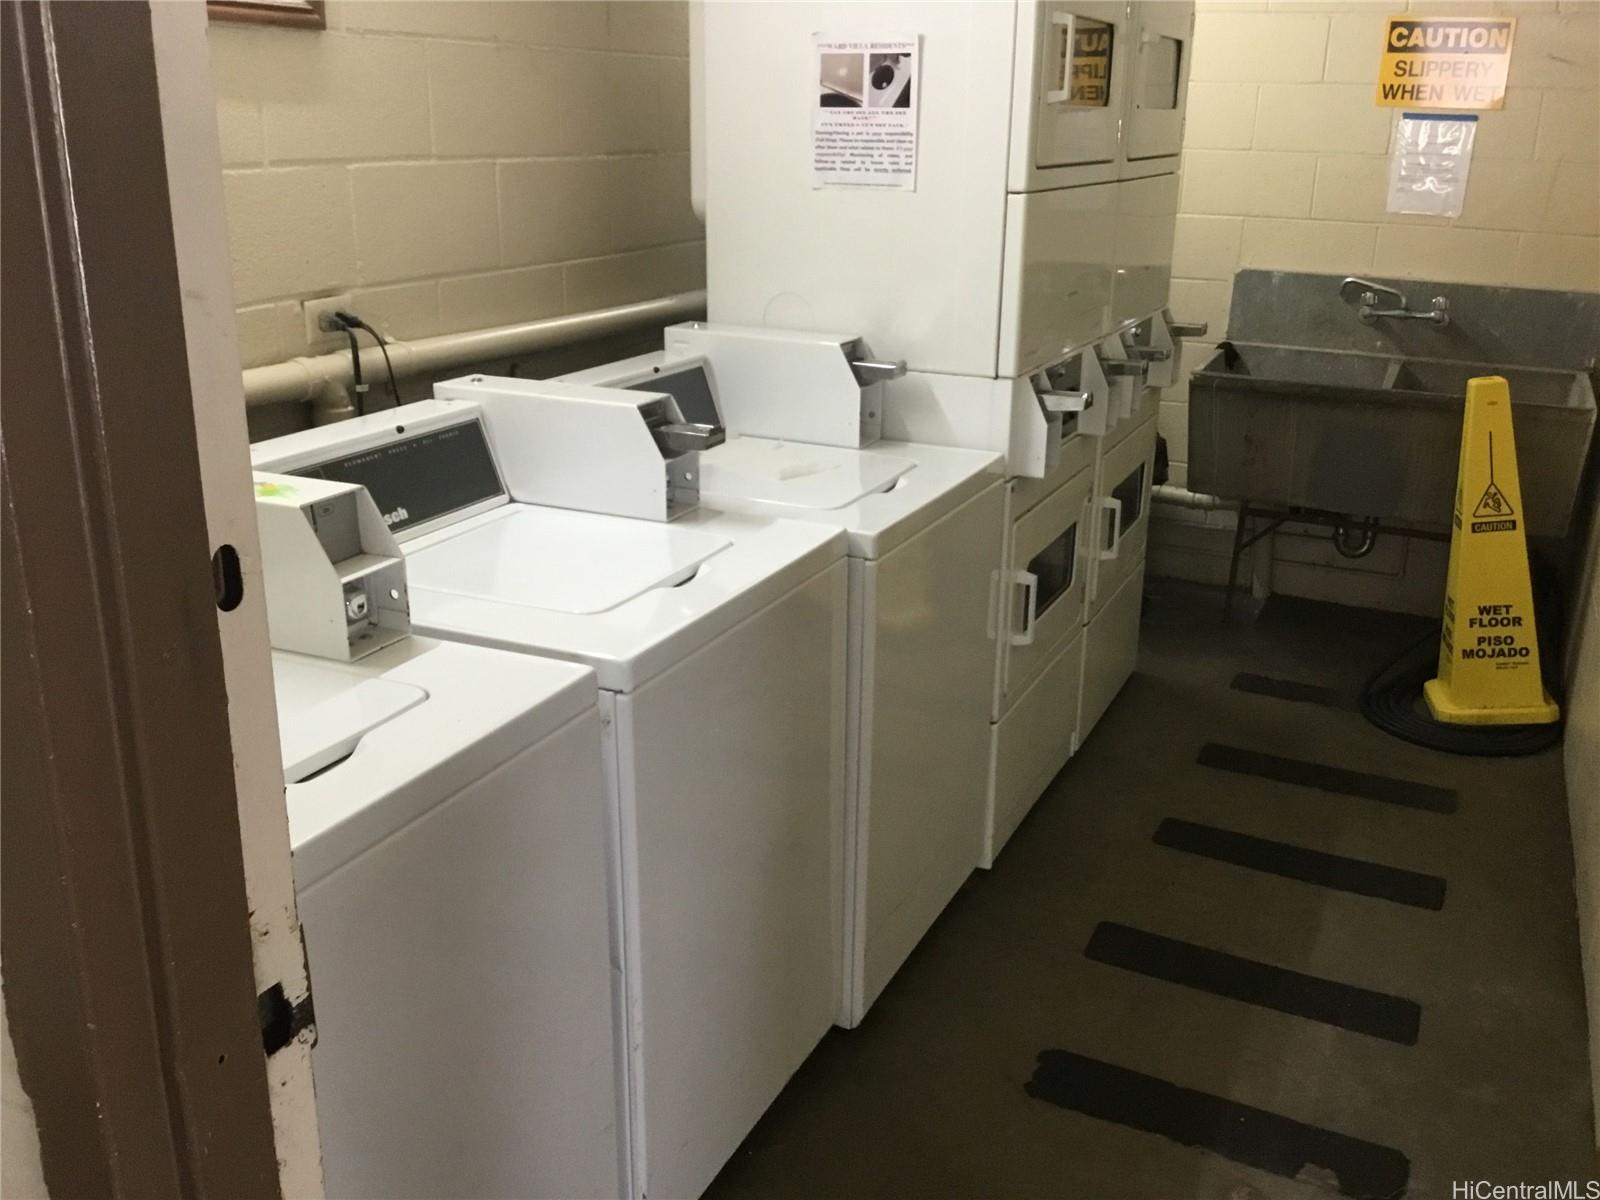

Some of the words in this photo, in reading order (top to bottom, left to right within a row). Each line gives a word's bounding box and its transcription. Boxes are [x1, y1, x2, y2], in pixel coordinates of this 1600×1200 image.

[1389, 26, 1511, 48] CAUTION
[1393, 60, 1494, 79] SLIPPERY
[1382, 83, 1444, 101] WHEN
[1454, 85, 1502, 102] WET
[1474, 521, 1513, 532] CAUTION
[1478, 604, 1513, 616] WET
[1468, 616, 1523, 628] FLOOR
[1477, 635, 1515, 647] PISO
[1461, 646, 1530, 660] MOJADO
